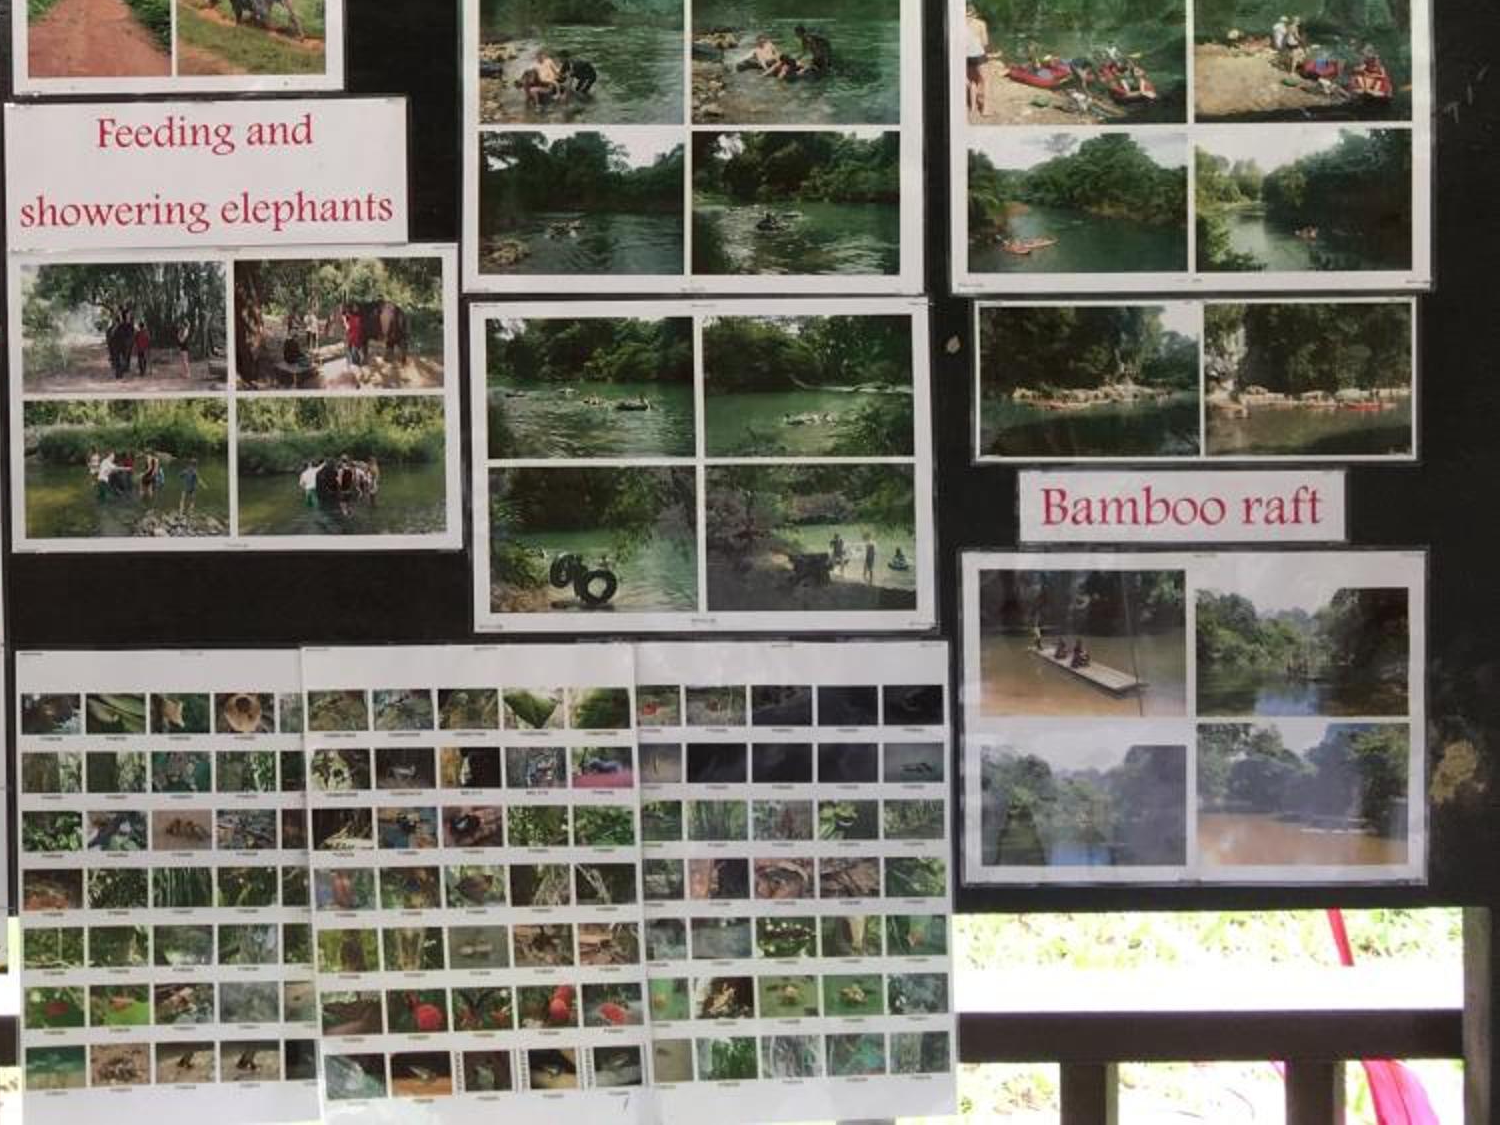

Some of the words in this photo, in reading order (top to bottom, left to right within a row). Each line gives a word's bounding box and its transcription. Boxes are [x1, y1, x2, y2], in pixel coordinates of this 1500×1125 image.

[97, 115, 236, 156] Feeding
[246, 113, 314, 147] and
[19, 193, 211, 235] showering
[220, 188, 394, 232] elephants
[1041, 485, 1227, 527] Bamboo
[1241, 484, 1323, 526] raft
